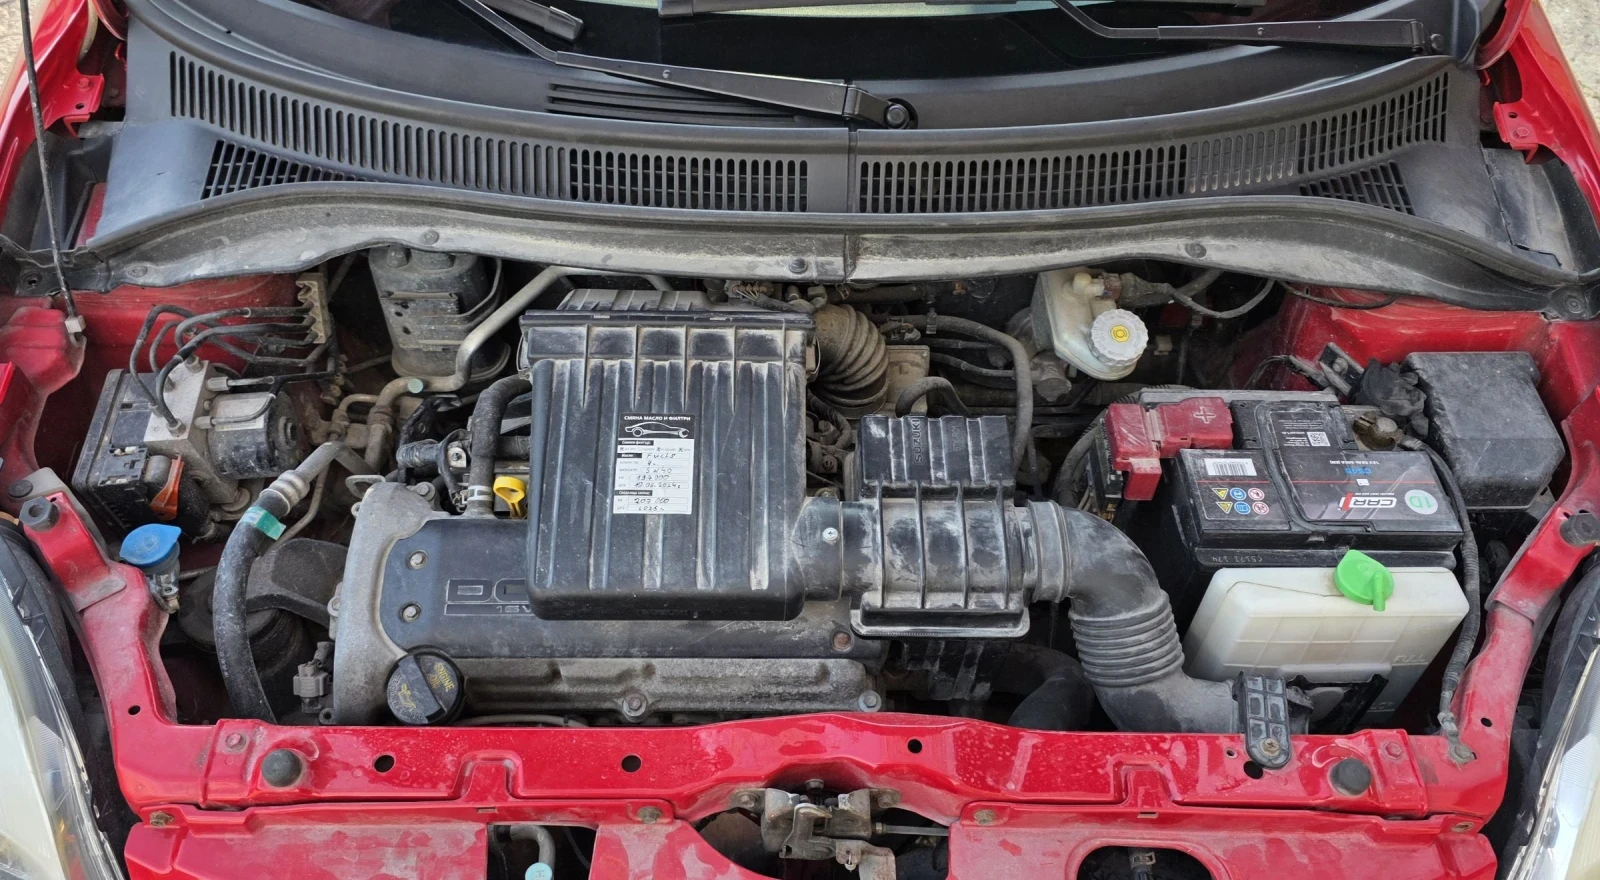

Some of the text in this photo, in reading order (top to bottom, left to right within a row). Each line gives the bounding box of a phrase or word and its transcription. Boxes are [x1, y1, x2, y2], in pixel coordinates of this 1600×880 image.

[910, 418, 923, 463] SUZUKI
[1408, 495, 1433, 509] 1D
[1393, 654, 1425, 662] FULL
[428, 673, 440, 689] OIL
[433, 662, 455, 693] ENGINE
